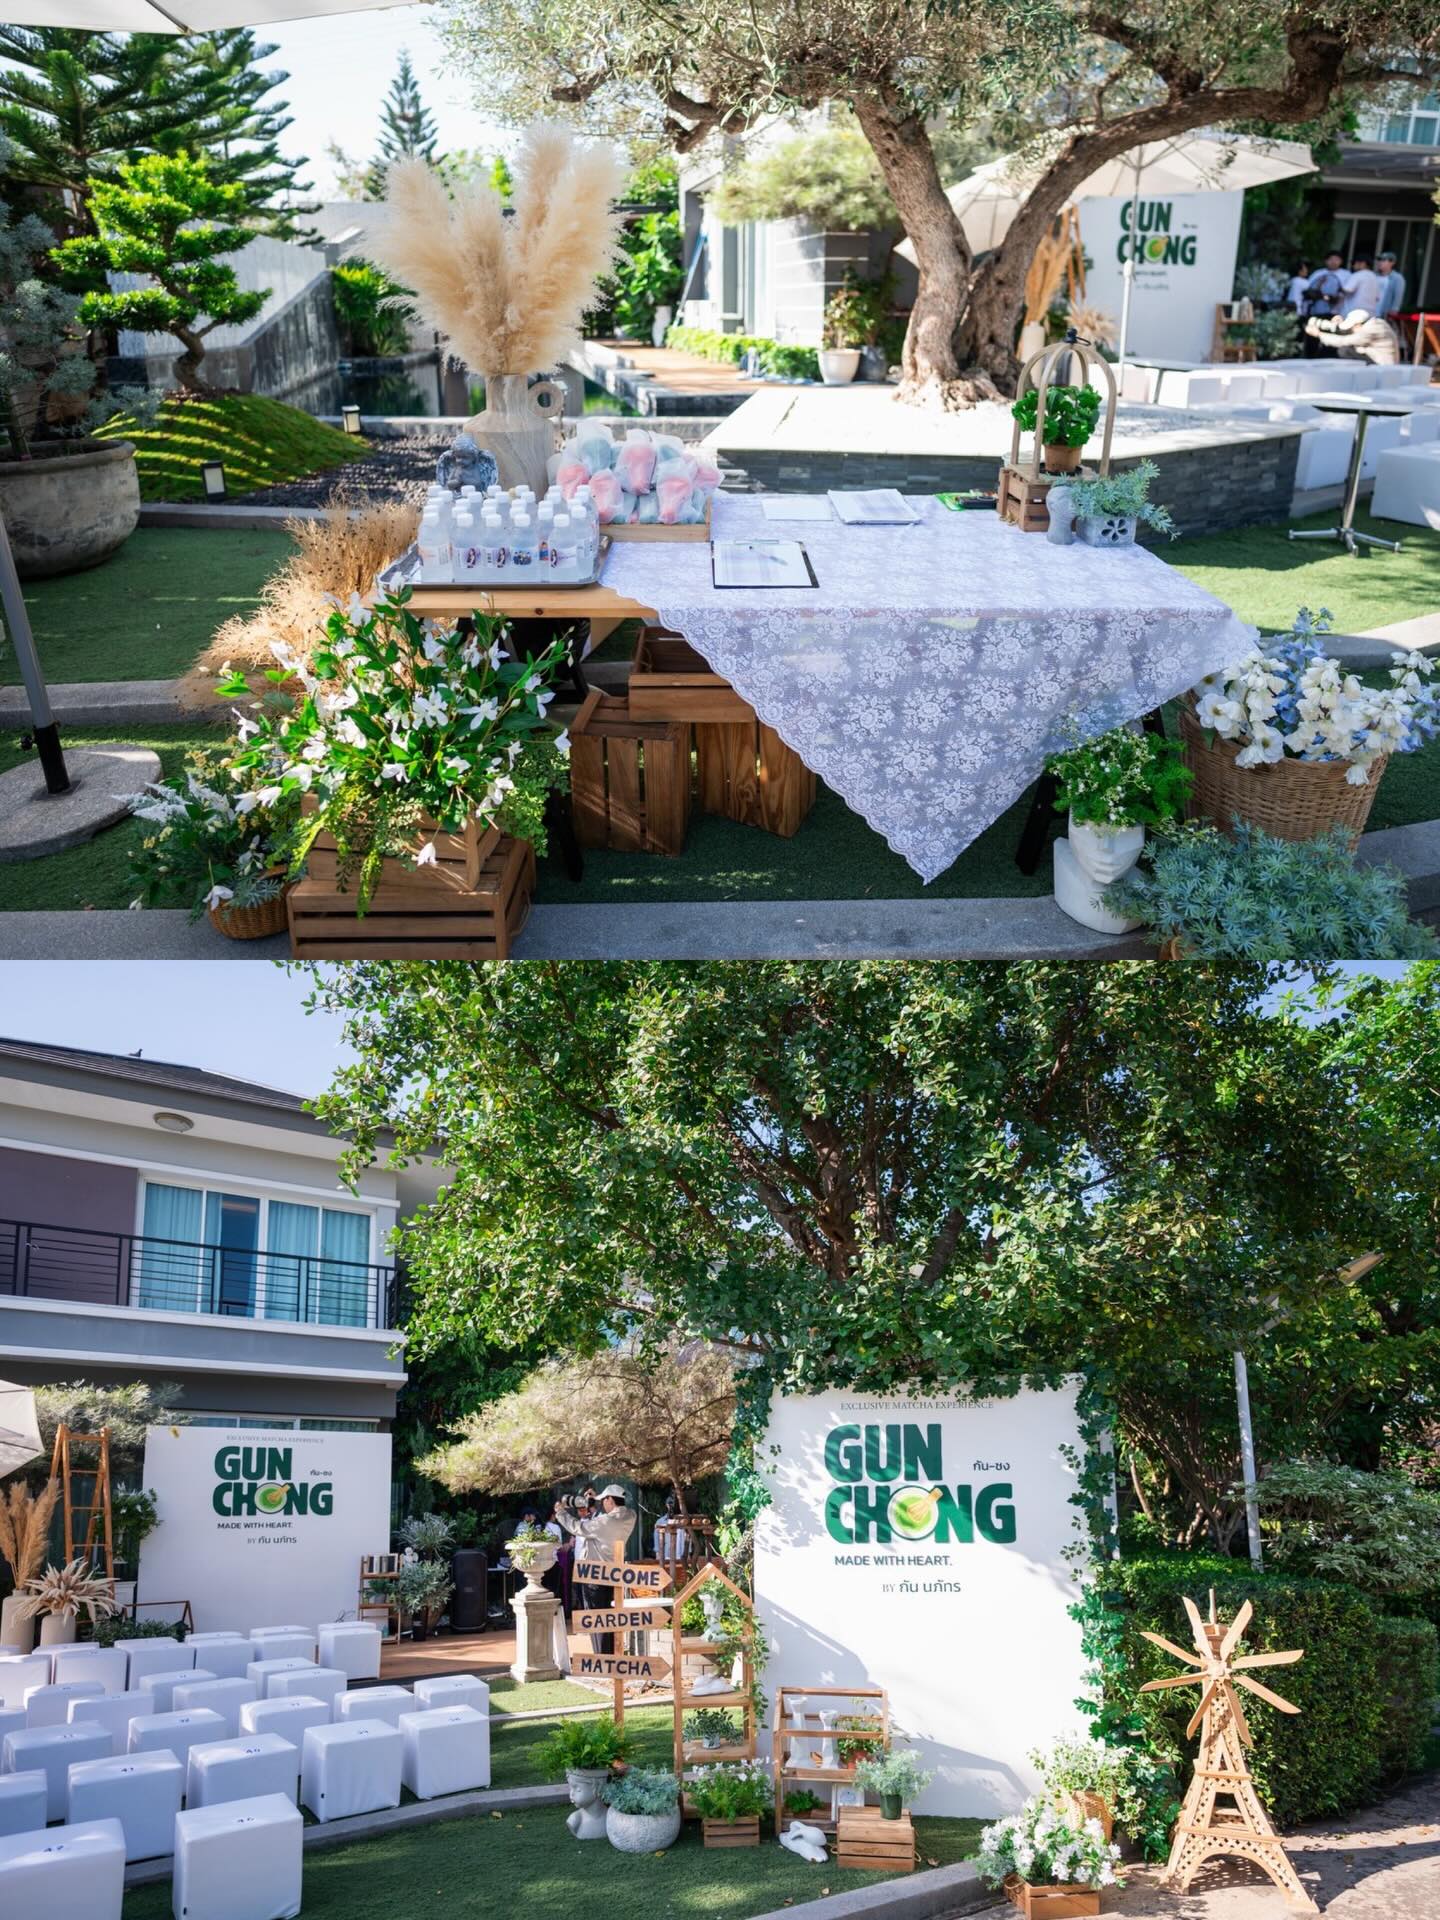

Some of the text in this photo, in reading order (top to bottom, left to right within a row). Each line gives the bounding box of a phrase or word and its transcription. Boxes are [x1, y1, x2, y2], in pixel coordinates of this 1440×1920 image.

[1120, 201, 1172, 232] GUN
[840, 1400, 994, 1411] EXCLUSIVE MATCHA EXPERIENCE
[824, 1423, 943, 1483] GUN
[214, 1445, 293, 1481] GUN
[973, 1459, 1011, 1471] กัน-ชง
[212, 1482, 333, 1517] CHONG
[824, 1483, 1017, 1544] CHONG
[217, 1522, 241, 1530] MADE
[243, 1521, 264, 1529] WITH
[834, 1555, 953, 1567] MADE WITH HEART.
[577, 1563, 660, 1586] WELCOME
[882, 1583, 896, 1593] BY
[899, 1579, 919, 1593] กัน
[581, 1612, 652, 1628] GARDEN
[581, 1659, 652, 1676] MATCHA
